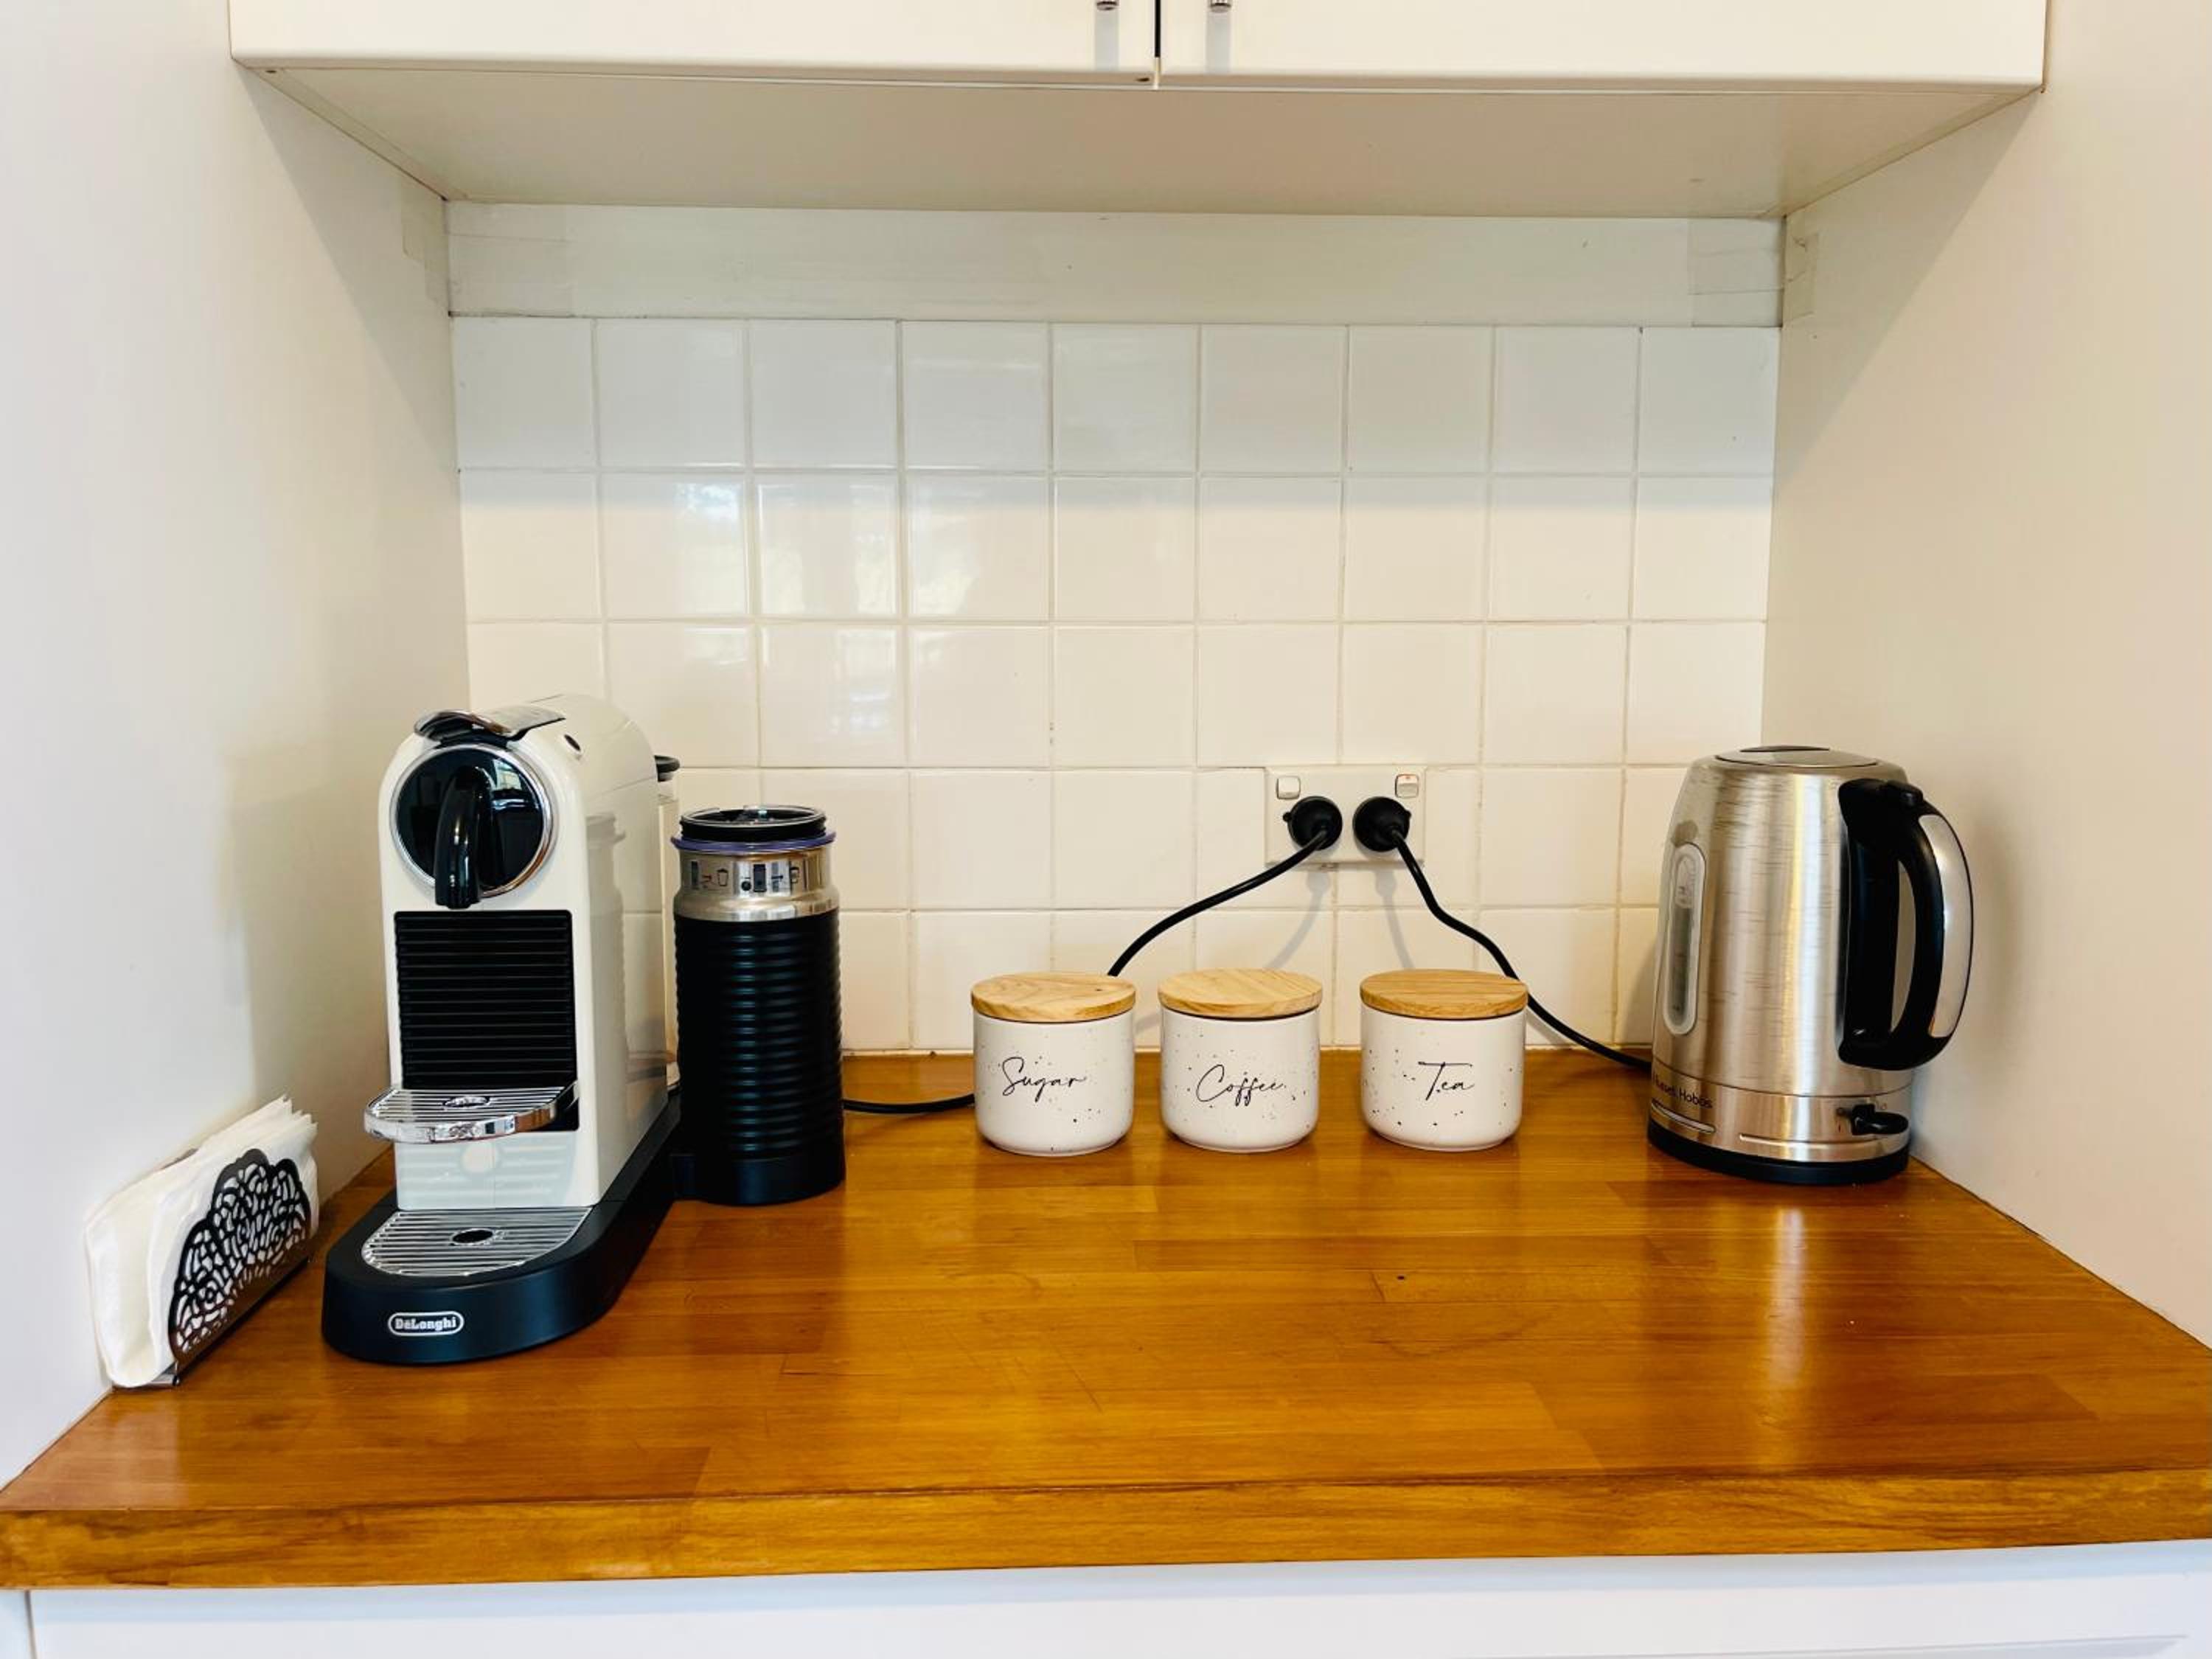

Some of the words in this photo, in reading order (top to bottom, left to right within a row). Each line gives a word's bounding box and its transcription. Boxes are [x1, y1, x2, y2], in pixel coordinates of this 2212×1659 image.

[1002, 1057, 1087, 1102] Sugar
[1195, 1064, 1284, 1107] Coffee
[1418, 1061, 1475, 1101] Tea
